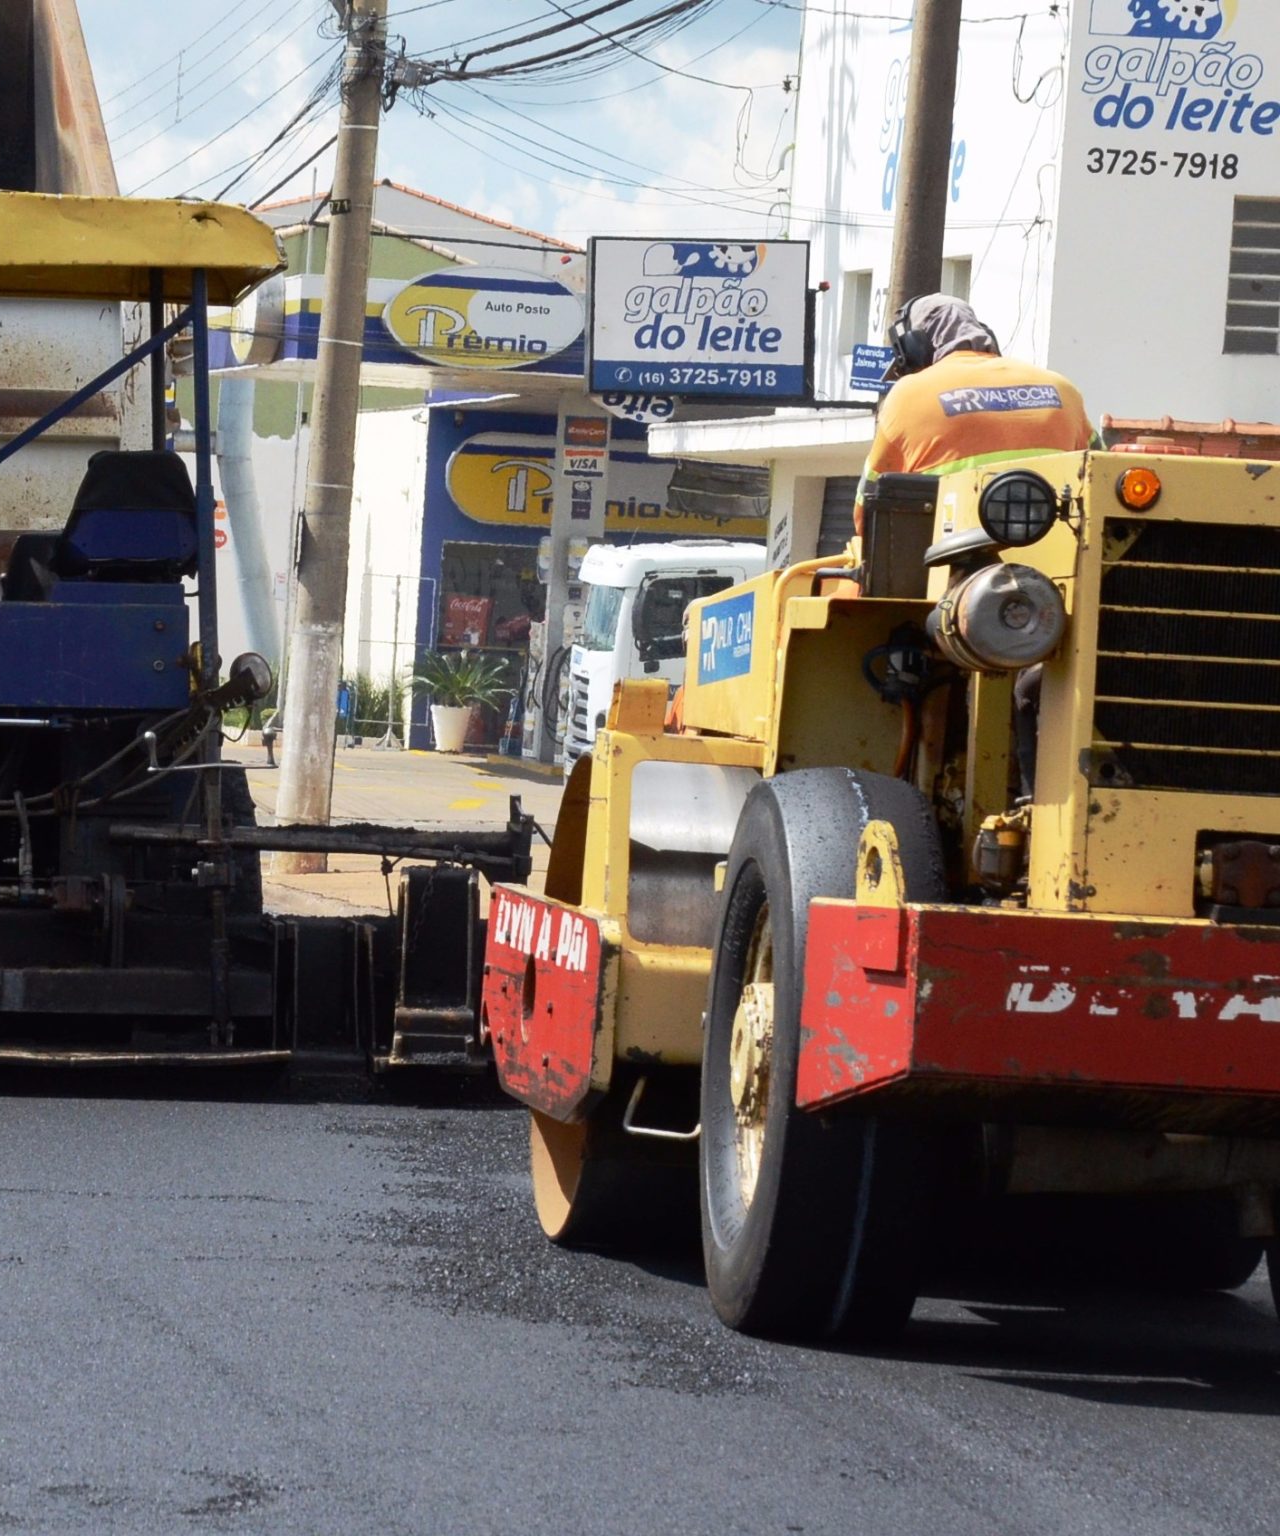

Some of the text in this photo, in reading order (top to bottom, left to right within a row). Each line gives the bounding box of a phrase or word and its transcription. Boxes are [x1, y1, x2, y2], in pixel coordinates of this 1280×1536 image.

[1082, 37, 1263, 96] galpão
[1093, 82, 1280, 135] do leite
[1087, 147, 1239, 180] 3725-7918
[485, 301, 551, 315] Auto Posto
[624, 277, 768, 324] galpão
[405, 304, 548, 354] Prêmio
[634, 315, 783, 353] do leite
[638, 368, 777, 387] (16) 3725-7918
[1007, 387, 1058, 402] ROCHA
[569, 459, 599, 470] VISA
